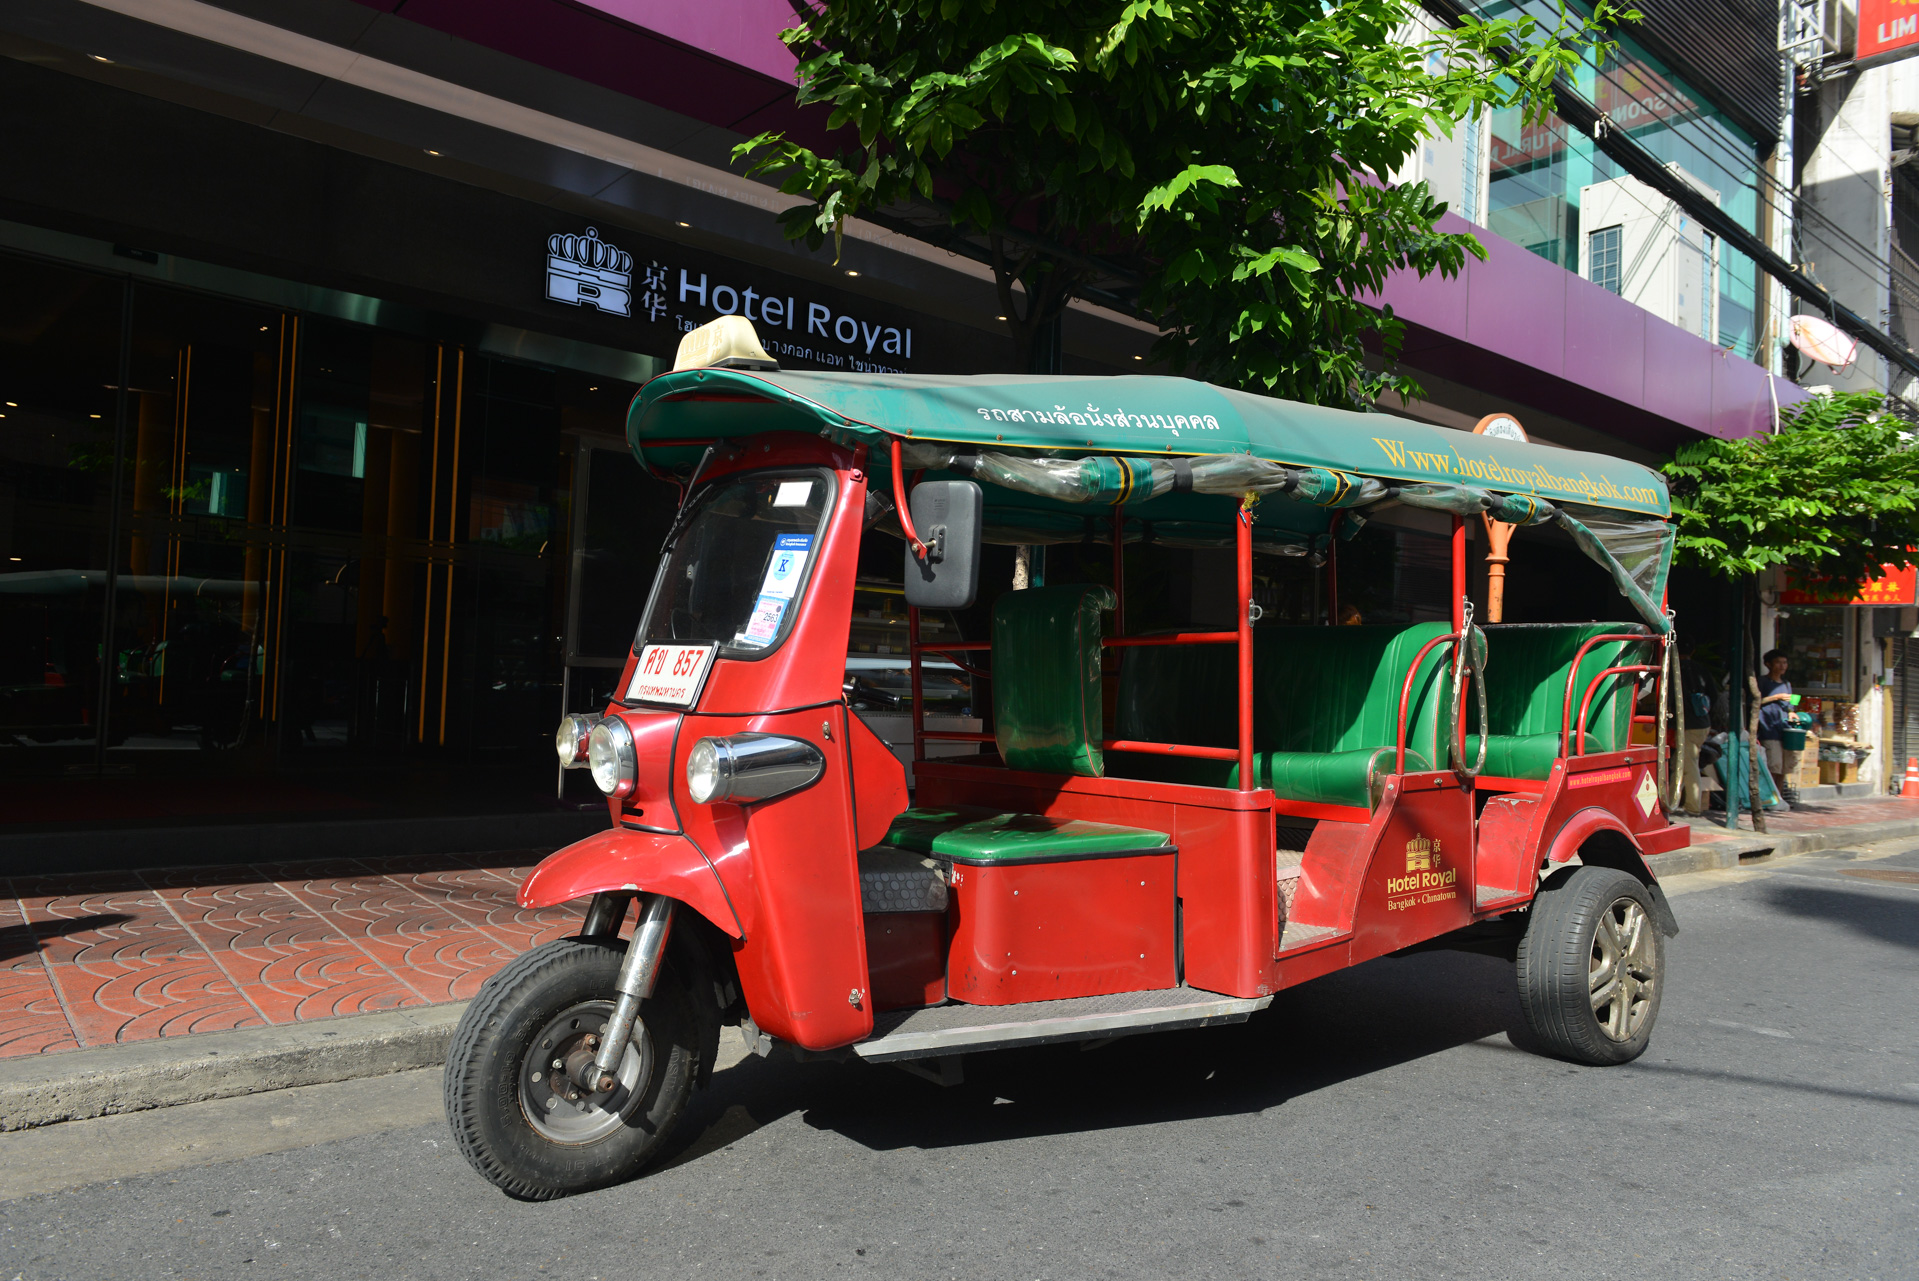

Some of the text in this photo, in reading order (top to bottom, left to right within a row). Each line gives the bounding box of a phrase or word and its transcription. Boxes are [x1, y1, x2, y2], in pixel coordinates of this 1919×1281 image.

[1878, 14, 1917, 44] LIM
[641, 260, 668, 322] 京华
[679, 268, 912, 359] Hotel Royal
[977, 403, 1220, 437] รถสามล้อนั่งส่วนบุคคล
[1372, 437, 1660, 505] Www.hotelroyalbangkok.com
[778, 559, 789, 572] K
[673, 650, 704, 677] 857
[638, 685, 686, 700] กรุงเทพมหานคร
[1569, 771, 1631, 786] www.hotelroyalbangkok.com
[1388, 868, 1456, 894] Hotel Royal
[1388, 891, 1456, 911] Bangkok Chinatown
